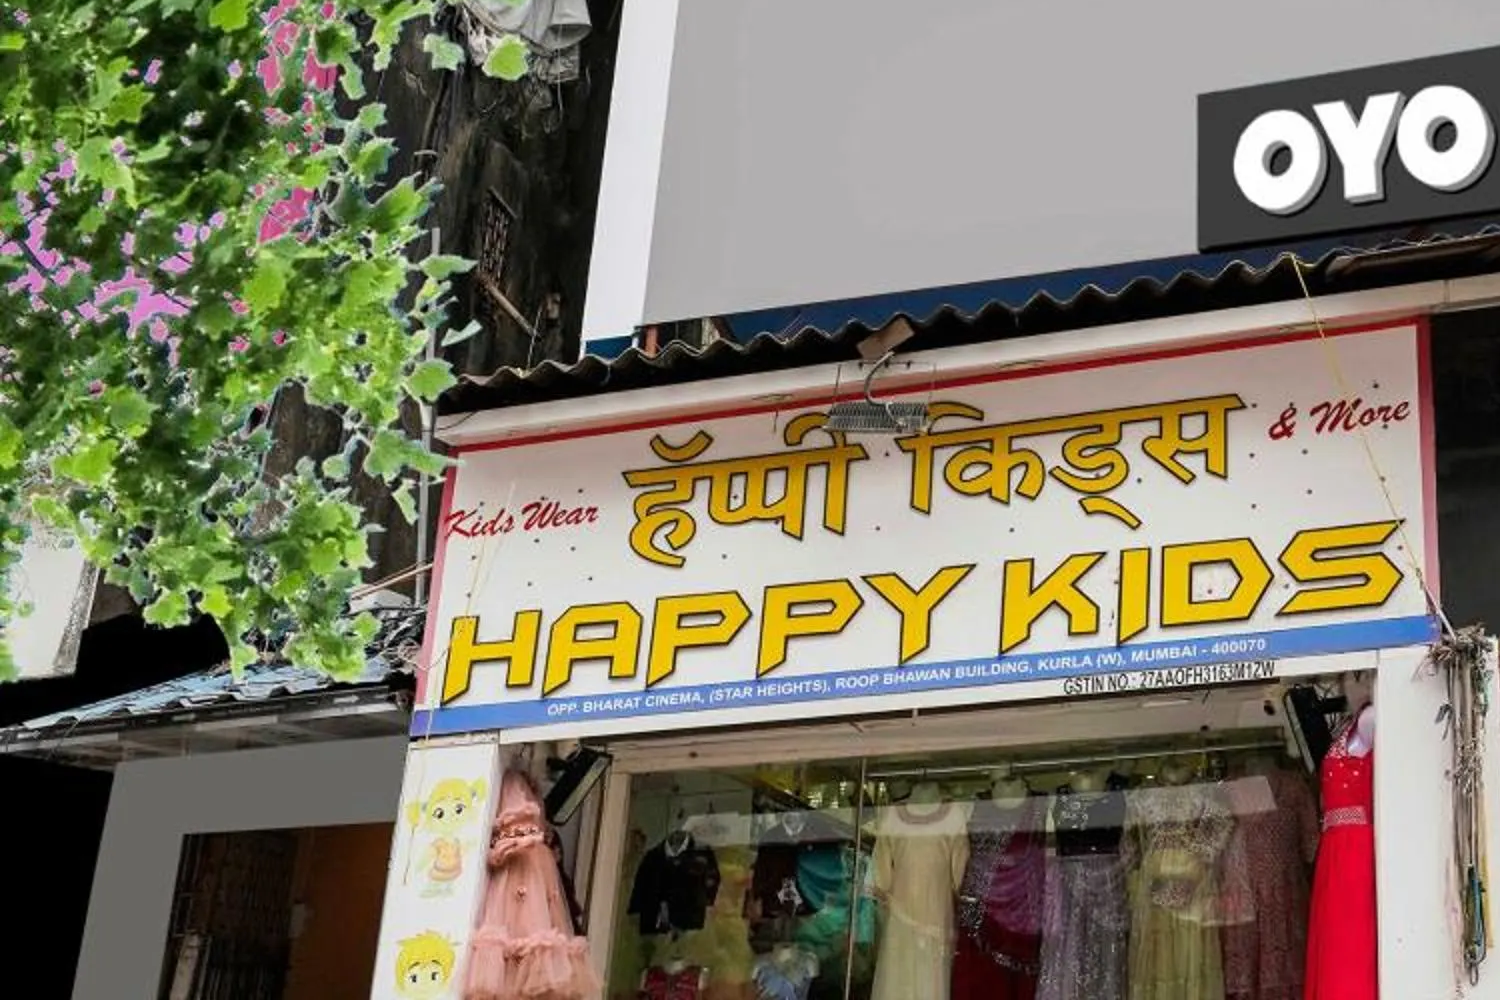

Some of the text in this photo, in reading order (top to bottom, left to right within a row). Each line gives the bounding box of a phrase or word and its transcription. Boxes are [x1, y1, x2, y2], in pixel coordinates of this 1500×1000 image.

[1233, 85, 1495, 215] OYO
[1309, 397, 1411, 434] More
[444, 500, 599, 539] Kids Wear
[440, 518, 1406, 706] HAPPY KIDS
[547, 702, 580, 717] OPP.
[583, 696, 643, 714] BHARAT
[645, 692, 705, 708] CINEMA,
[709, 687, 753, 704] (STAR
[757, 679, 833, 700] HEIGHTS),
[835, 674, 880, 690] ROOP
[883, 667, 950, 685] BHAWAN
[955, 661, 1034, 680] BUILDING,
[1038, 656, 1092, 671] KURLA
[1131, 644, 1197, 663] MUMBAI
[1211, 638, 1266, 655] 400070
[1063, 675, 1104, 695] GSTIN
